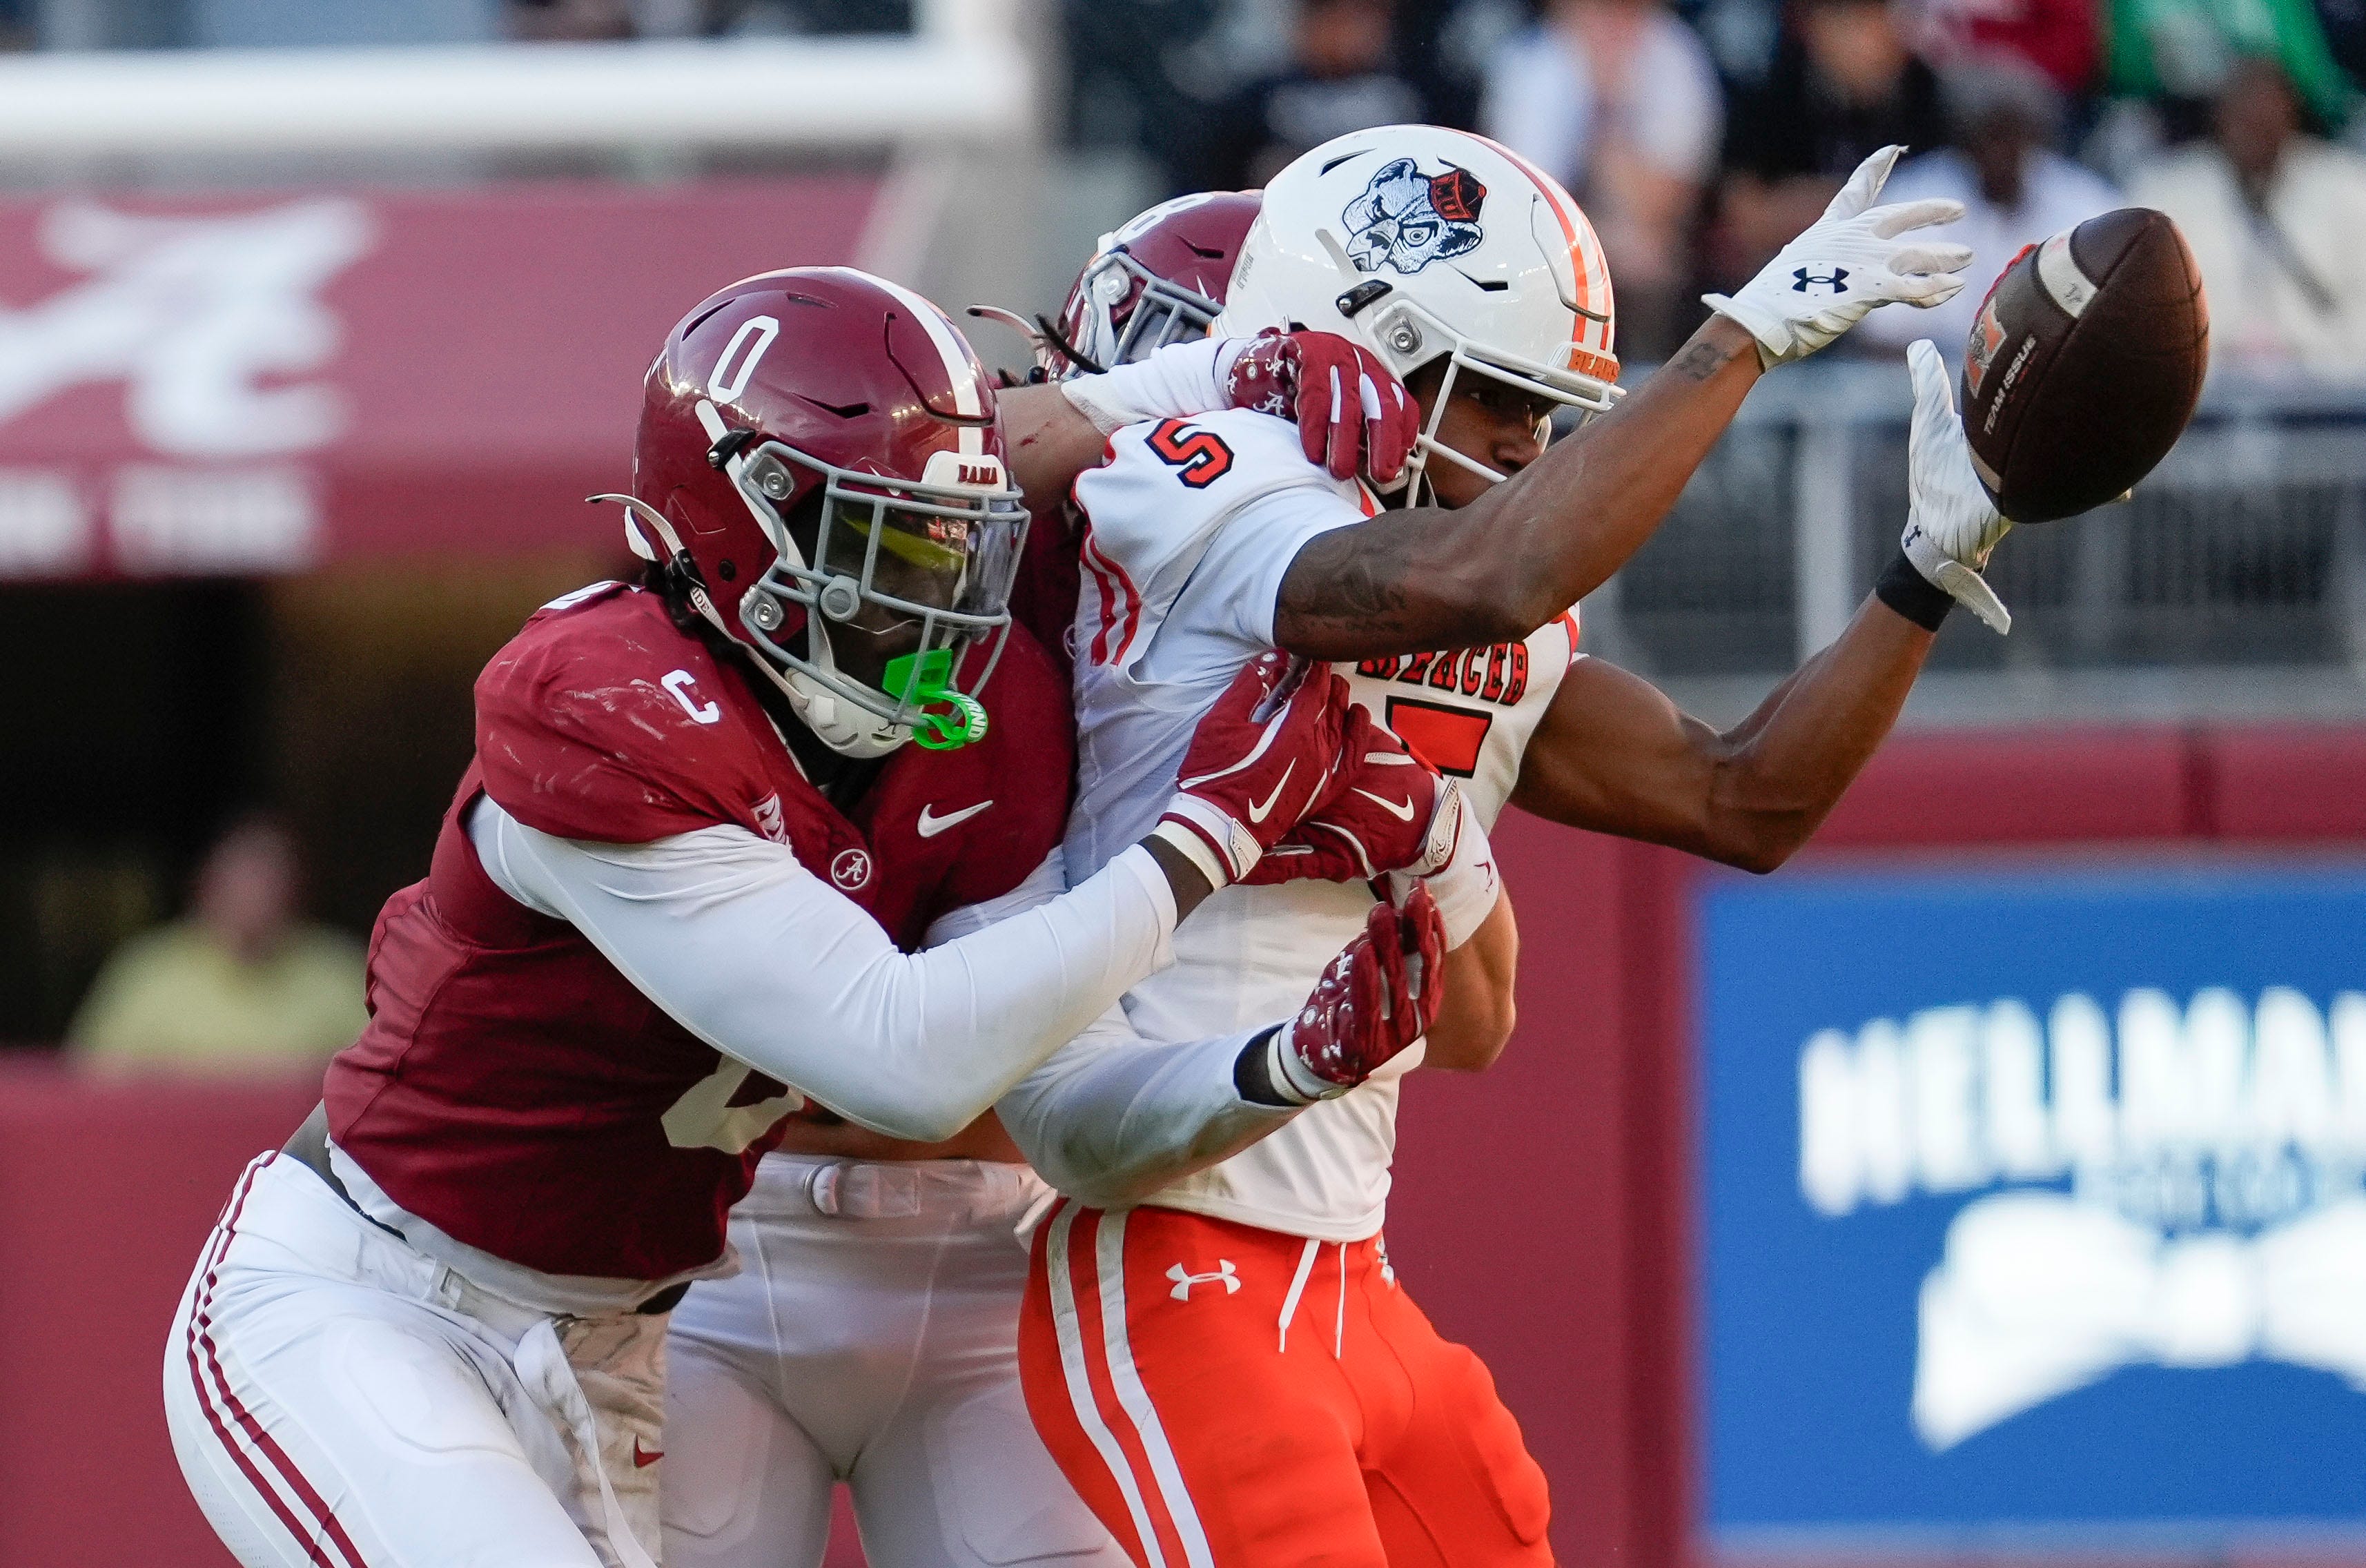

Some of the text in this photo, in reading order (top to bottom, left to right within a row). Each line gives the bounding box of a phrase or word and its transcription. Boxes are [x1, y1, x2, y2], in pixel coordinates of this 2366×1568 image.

[2003, 334, 2036, 389] ISSUE
[957, 464, 998, 484] BAMA
[660, 669, 720, 725] C
